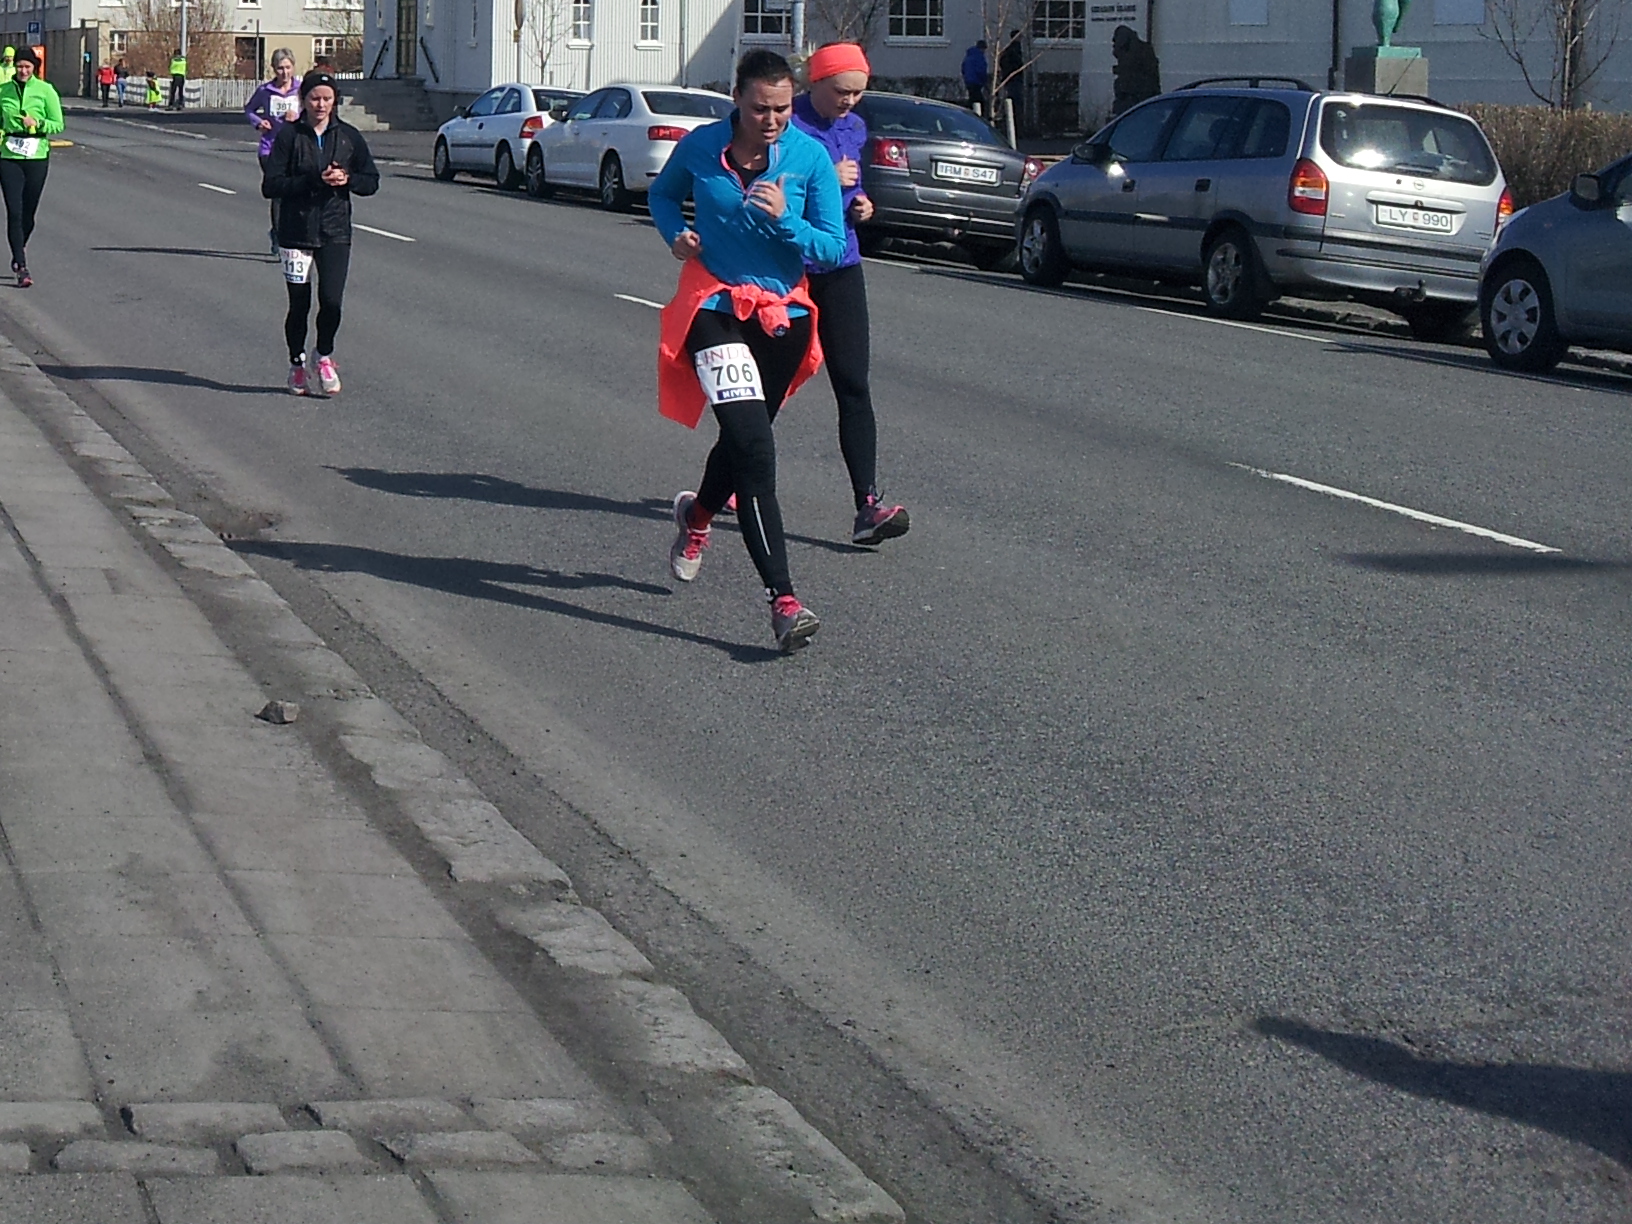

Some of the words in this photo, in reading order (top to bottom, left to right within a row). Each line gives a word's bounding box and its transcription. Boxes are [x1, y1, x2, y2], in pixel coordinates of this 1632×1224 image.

[1389, 208, 1408, 222] LY
[1422, 213, 1449, 228] 990
[284, 259, 304, 274] 113
[710, 363, 754, 387] 706
[721, 387, 753, 399] NIVEA
